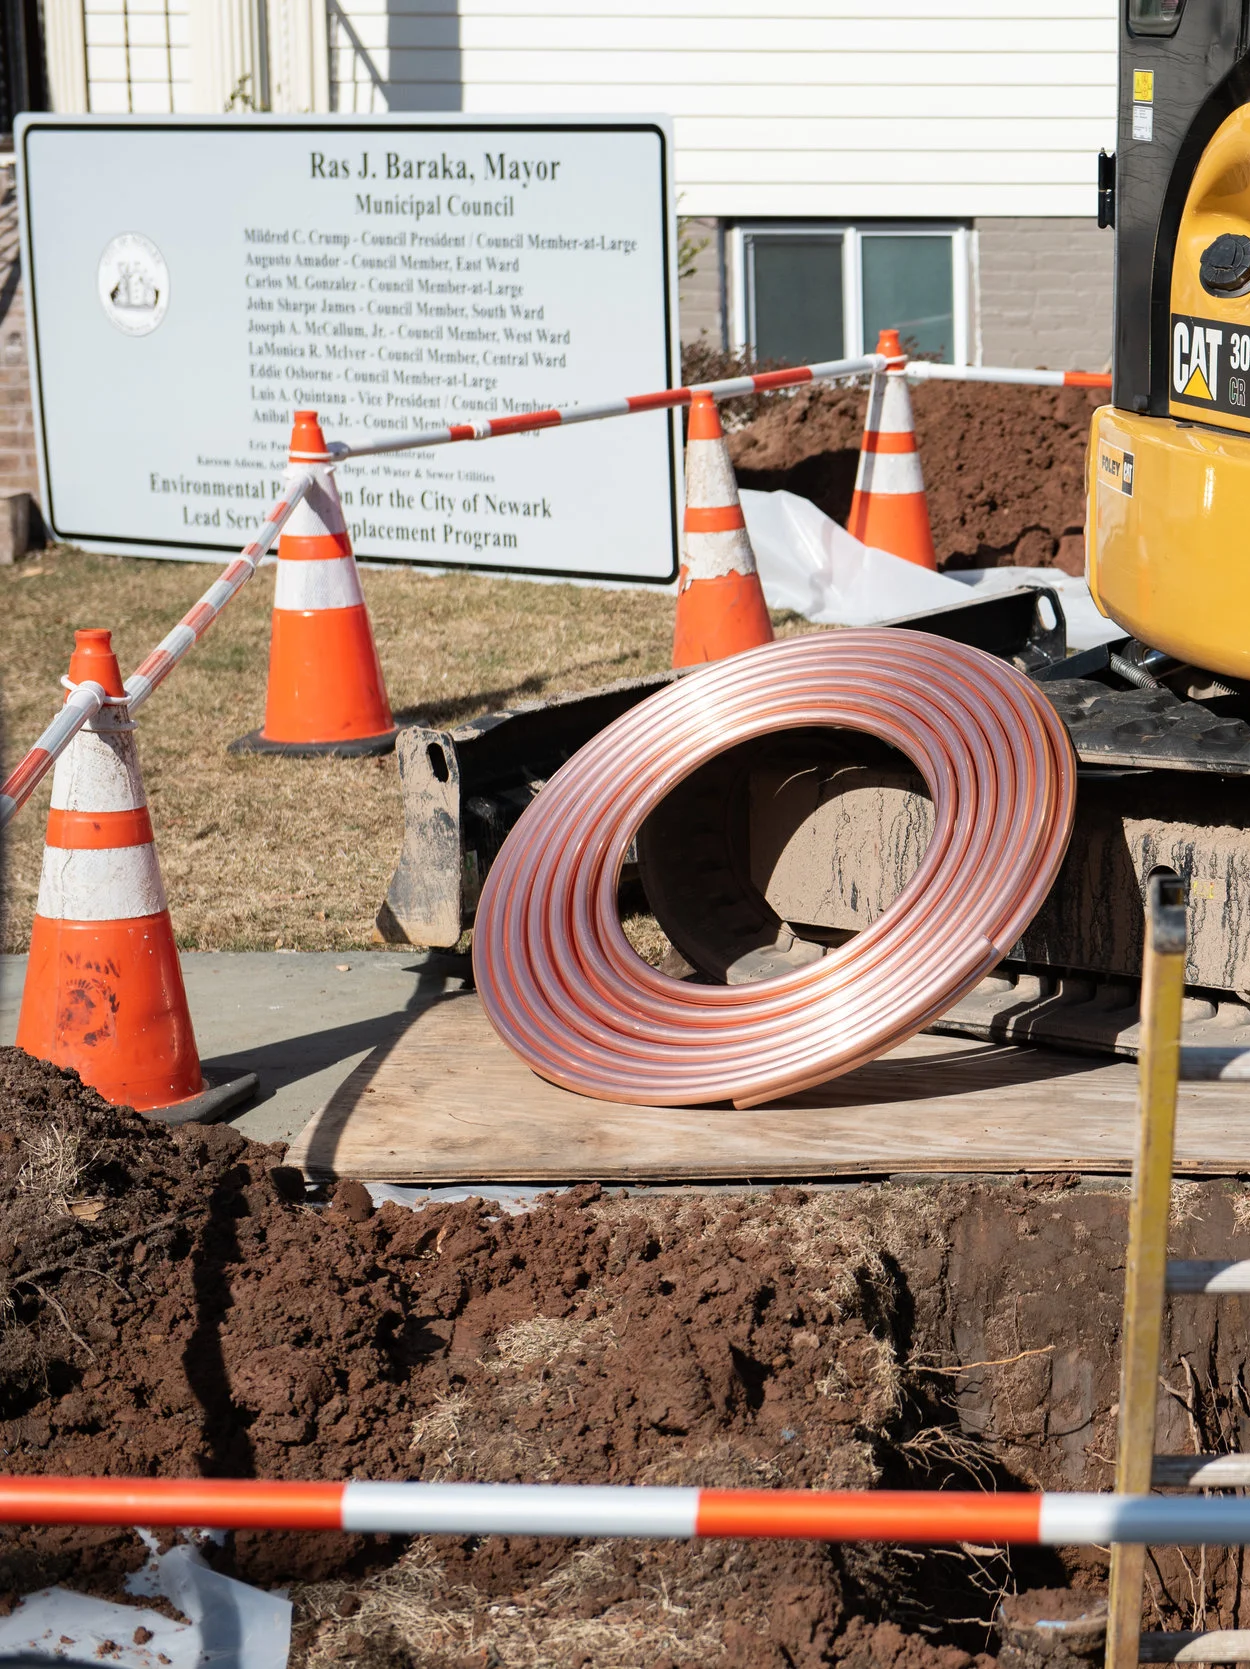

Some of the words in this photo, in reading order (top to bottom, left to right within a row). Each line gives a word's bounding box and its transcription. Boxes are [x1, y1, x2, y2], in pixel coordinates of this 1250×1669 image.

[310, 151, 350, 179] Ras
[358, 151, 376, 179] J.
[386, 152, 475, 185] Baraka,
[484, 152, 560, 189] Mayor
[355, 193, 441, 221] Municipal
[447, 194, 514, 217] Council
[244, 228, 289, 245] Mildred
[292, 229, 306, 245] C.
[308, 229, 350, 249] Crump
[361, 231, 406, 247] Council
[410, 232, 465, 248] President
[477, 233, 523, 249] Council
[528, 234, 637, 255] Member-at-Large
[245, 252, 291, 270] Augusto
[295, 253, 340, 268] Amador
[351, 254, 396, 269] Council
[400, 255, 453, 272] Member,
[456, 256, 481, 272] East
[486, 256, 519, 272] Ward
[245, 273, 282, 290] Carlos
[304, 275, 357, 291] Gonzalez
[368, 276, 413, 293] Council
[418, 277, 524, 298] Member-at-Large
[247, 297, 273, 312] John
[321, 299, 356, 314] James
[367, 300, 412, 316] Council
[416, 301, 468, 319] Member,
[472, 303, 506, 319] South
[510, 304, 544, 320] Ward
[248, 319, 285, 337] Joseph
[398, 324, 443, 340] Council
[447, 325, 500, 343] Member,
[503, 327, 532, 344] West
[536, 328, 570, 345] Ward
[378, 347, 423, 363] Council
[427, 348, 479, 367] Member,
[483, 350, 528, 367] Central
[532, 351, 566, 368] Ward
[1173, 321, 1223, 401] CAT
[250, 363, 281, 379] Eddie
[285, 364, 333, 381] Osborne
[344, 367, 389, 384] Council
[393, 369, 498, 391] Member-at-Large
[250, 385, 275, 401] Luis
[293, 387, 347, 405] Quintana
[357, 390, 383, 407] Vice
[386, 391, 441, 409] President
[452, 394, 498, 412] Council
[1229, 376, 1246, 406] CR
[363, 413, 408, 430] Council
[371, 465, 380, 476] of
[383, 466, 411, 478] Water
[414, 467, 421, 479] &
[426, 469, 454, 481] Sewer
[457, 470, 495, 483] Utilities
[1101, 455, 1121, 476] FOLEY
[150, 473, 265, 499] Environmental
[360, 486, 383, 508] for
[389, 488, 415, 510] the
[421, 489, 455, 517] City
[462, 493, 479, 514] of
[485, 493, 552, 519] Newark
[183, 505, 221, 527] Lead
[443, 522, 517, 552] Program
